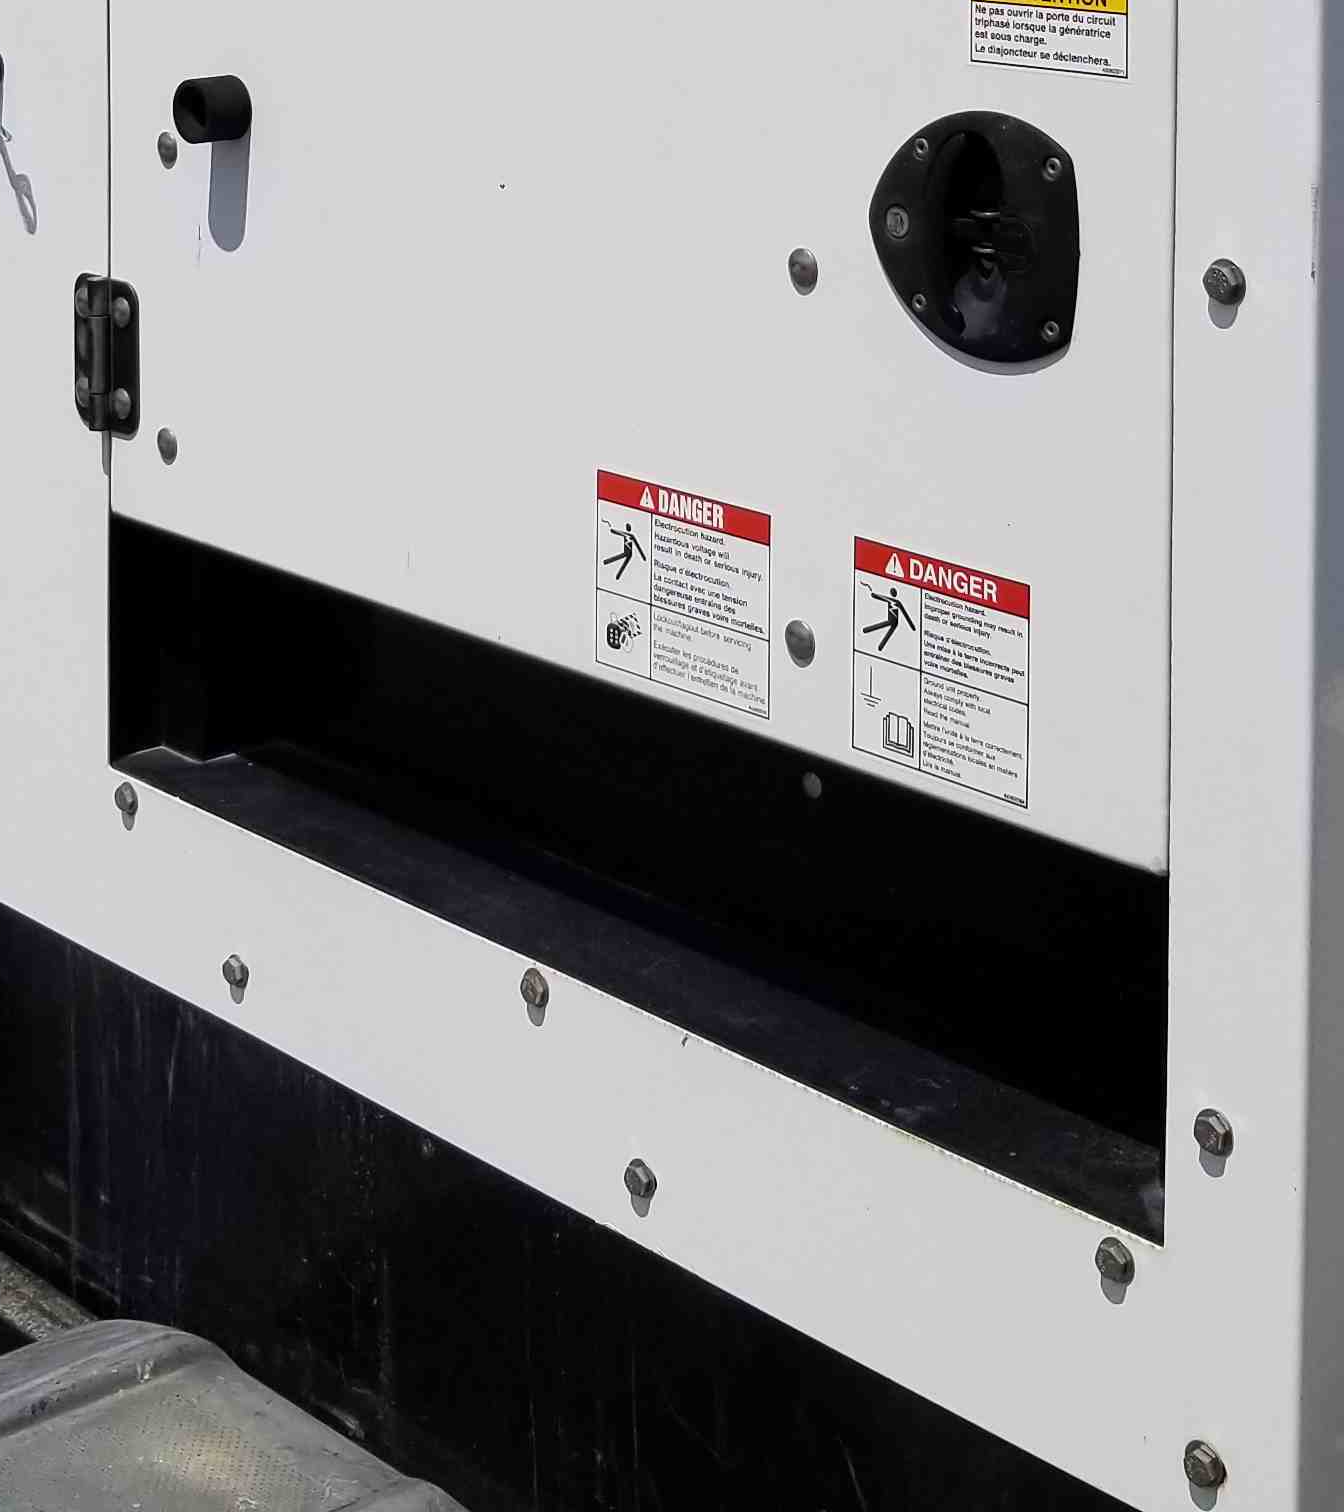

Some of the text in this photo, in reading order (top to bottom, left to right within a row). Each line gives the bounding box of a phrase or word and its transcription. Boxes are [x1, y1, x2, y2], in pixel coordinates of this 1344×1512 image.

[989, 8, 1004, 17] pas
[1007, 8, 1033, 18] ouvrir
[1046, 12, 1069, 23] porte
[1086, 15, 1115, 26] circuit
[1012, 20, 1045, 34] lorsque
[990, 32, 1011, 40] sous
[1014, 33, 1046, 46] charge.
[987, 44, 1036, 59] disjoncteur
[658, 488, 724, 529] DANGER
[654, 518, 698, 538] Electrocution
[691, 543, 715, 557] voltage
[654, 543, 671, 554] result
[684, 551, 701, 562] death
[714, 560, 738, 573] serious
[909, 557, 998, 603] DANGER
[722, 593, 747, 607] tension
[688, 605, 709, 618] graves
